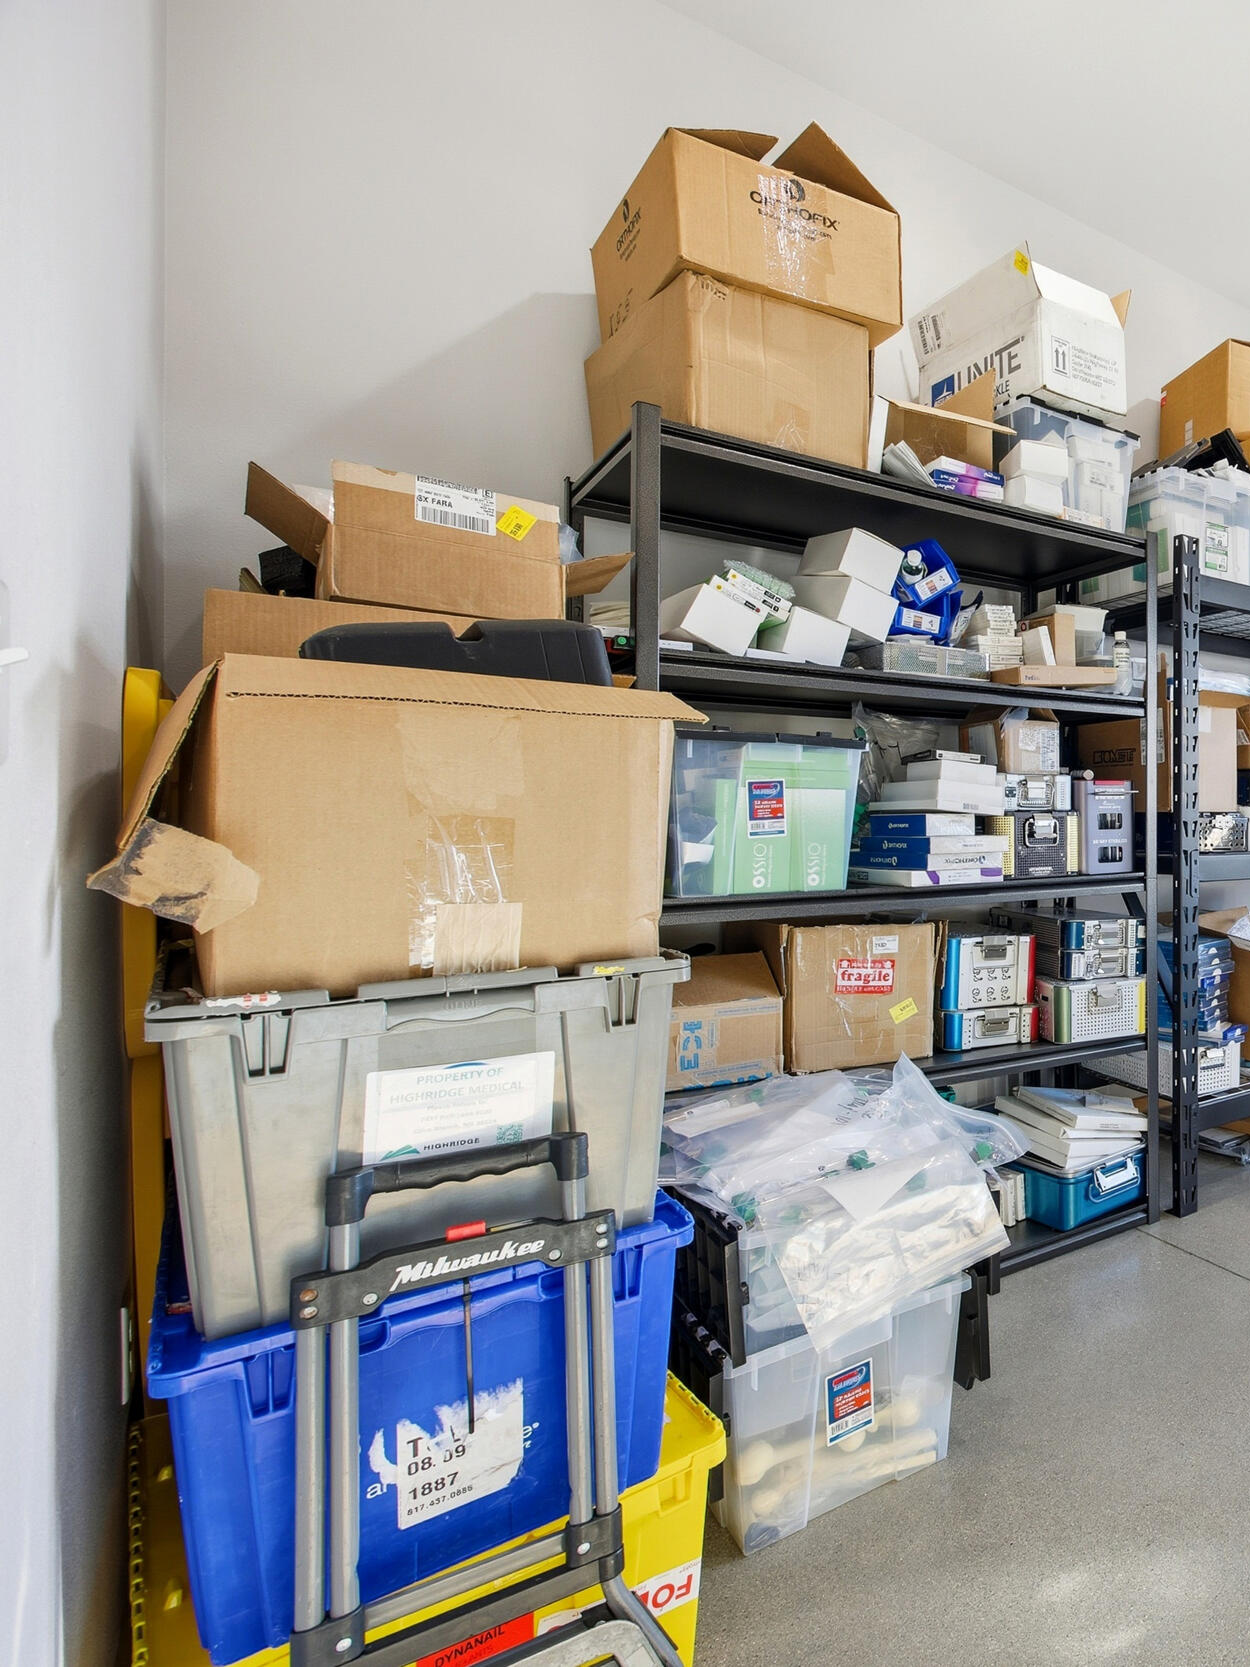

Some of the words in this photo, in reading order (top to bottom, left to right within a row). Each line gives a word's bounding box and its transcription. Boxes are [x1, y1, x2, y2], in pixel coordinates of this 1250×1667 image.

[752, 843, 767, 888] OSSIO
[840, 969, 890, 984] fragile
[416, 1068, 484, 1085] PROPERTY
[486, 1067, 505, 1078] OF
[390, 1086, 466, 1105] HIGHRIDGE
[467, 1080, 525, 1096] MEDICAL
[423, 1136, 481, 1151] HIGHRIDGE
[389, 1239, 545, 1292] Milwaukee
[408, 1471, 460, 1501] 1887
